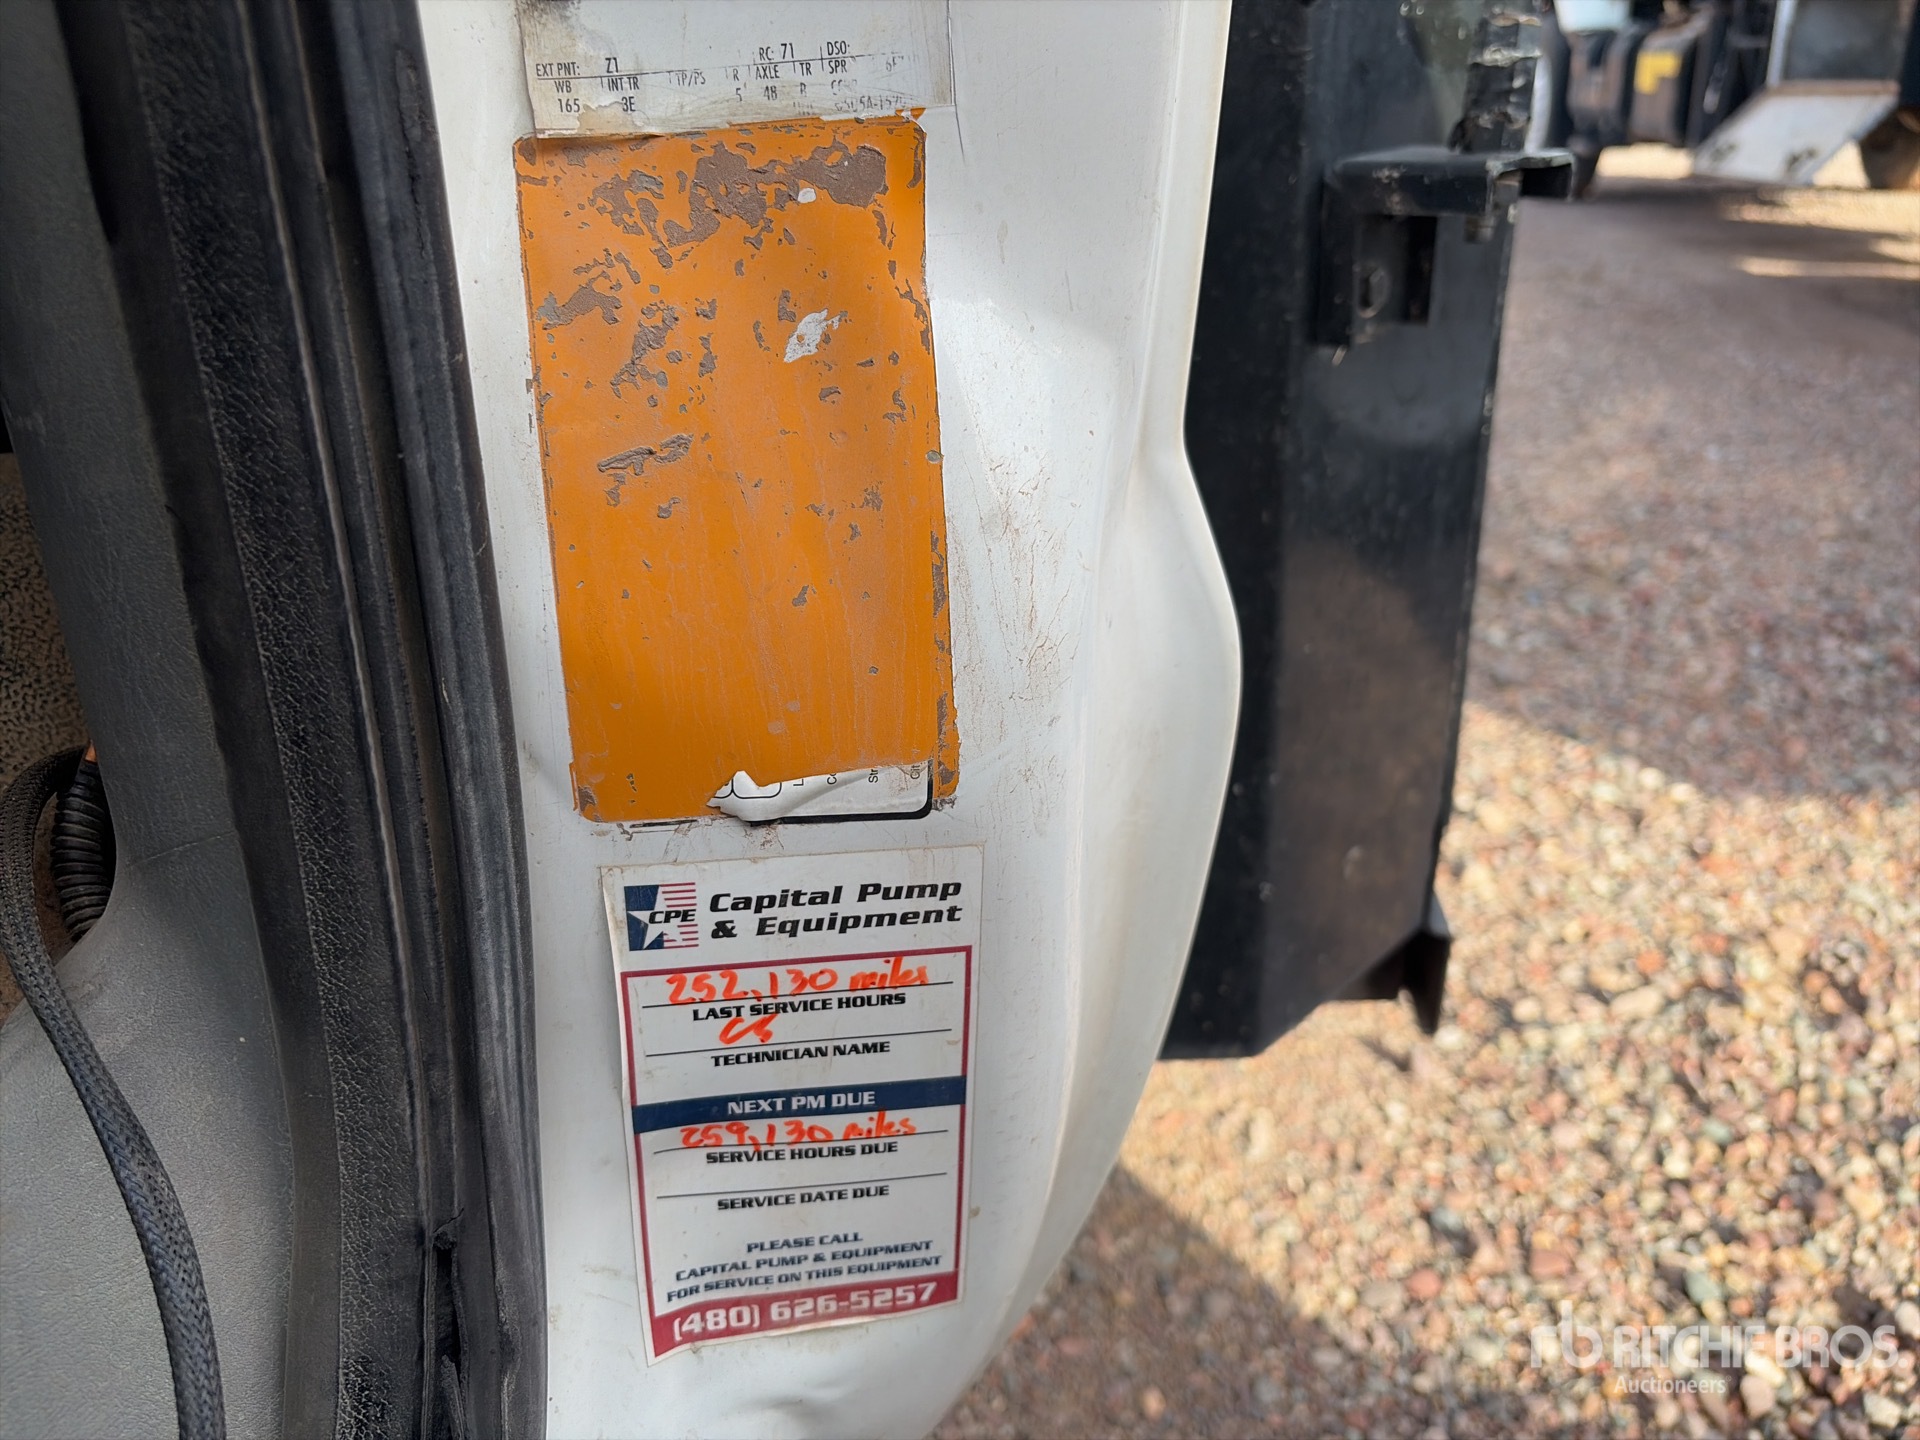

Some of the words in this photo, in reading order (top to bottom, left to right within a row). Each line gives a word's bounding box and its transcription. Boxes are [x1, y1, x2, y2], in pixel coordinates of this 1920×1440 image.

[759, 46, 774, 61] RC:
[780, 43, 794, 59] 71
[826, 40, 850, 56] DSO:
[535, 63, 554, 77] EXT
[557, 61, 581, 76] PNT:
[605, 57, 619, 74] Z1
[733, 68, 740, 82] R
[755, 64, 780, 80] AXLE
[800, 62, 812, 76] TR
[828, 59, 847, 74] SPR
[554, 80, 572, 93] WB
[607, 77, 623, 92] INT
[627, 76, 640, 91] TR
[675, 71, 706, 87] TP/PS
[558, 98, 581, 113] 165
[621, 96, 636, 112] 3E
[868, 768, 879, 784] Str
[709, 886, 843, 914] Capital
[857, 882, 962, 904] Pump
[649, 909, 696, 924] CPE
[711, 920, 738, 939] &
[756, 906, 962, 938] Equipment
[693, 1006, 744, 1022] LAST
[750, 998, 832, 1016] SERVICE
[837, 993, 906, 1009] HOURS
[712, 1046, 828, 1068] TECHNICIAN
[832, 1042, 890, 1057] NAME
[727, 1098, 786, 1115] NEXT
[791, 1094, 827, 1110] PM
[832, 1091, 875, 1107] DUE
[706, 1149, 786, 1164] SERVICE
[791, 1146, 856, 1160] HOURS
[860, 1141, 898, 1155] DUE
[717, 1194, 795, 1210] SERVICE
[800, 1189, 849, 1203] DATE
[852, 1185, 889, 1199] DUE
[746, 1237, 815, 1253] PLEASE
[819, 1232, 863, 1246] CALL
[675, 1260, 752, 1282] CAPITAL
[756, 1254, 809, 1269] PUMP
[813, 1252, 827, 1262] &
[831, 1240, 933, 1261] EQUIPMENT
[666, 1285, 701, 1303] FOR
[704, 1275, 774, 1292] SERVICE
[777, 1272, 802, 1283] ON
[805, 1266, 843, 1281] THIS
[847, 1255, 942, 1275] EQUIPMENT
[672, 1304, 760, 1342] (480)
[770, 1282, 937, 1322] 626-5257
